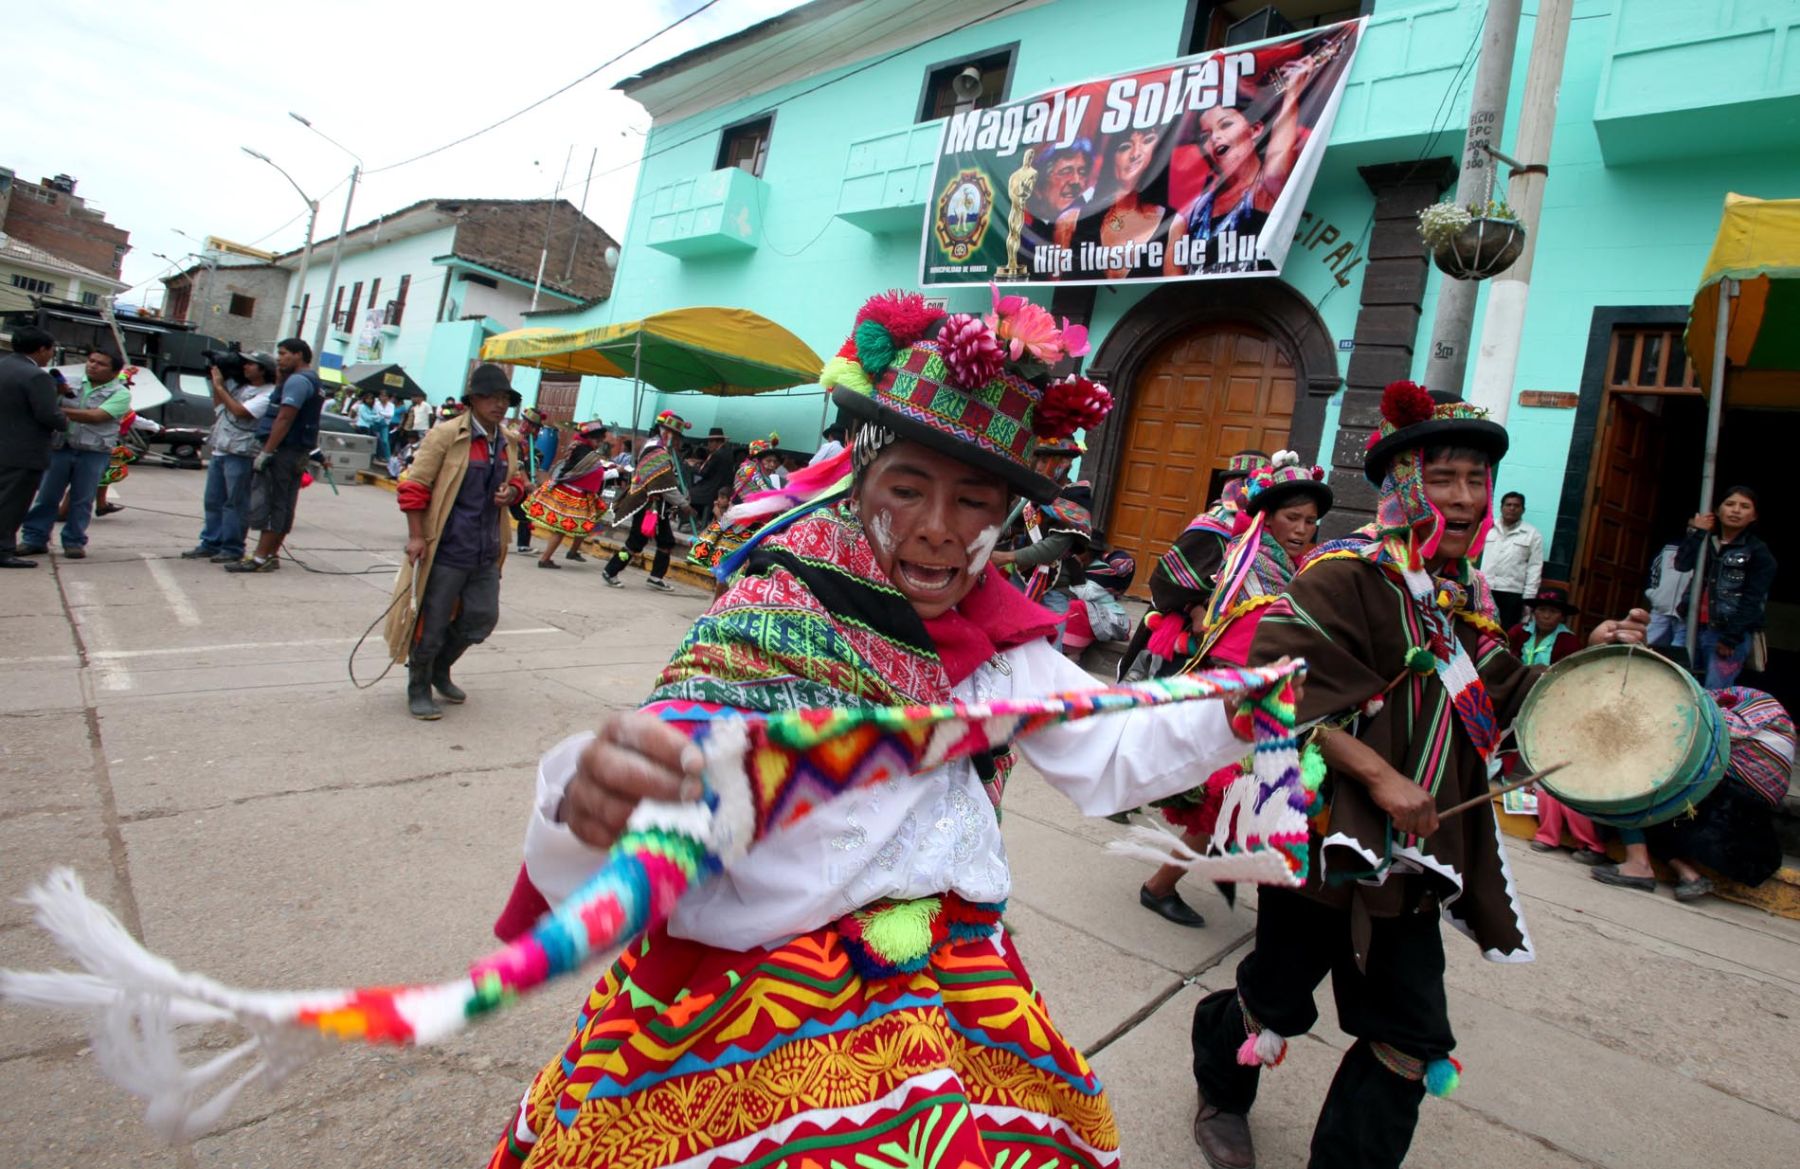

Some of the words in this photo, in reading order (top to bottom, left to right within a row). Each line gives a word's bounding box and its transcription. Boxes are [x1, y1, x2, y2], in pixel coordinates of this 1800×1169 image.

[945, 90, 1091, 157] Magaly
[1469, 126, 1492, 137] EPC
[1034, 244, 1073, 277] Hija
[1080, 240, 1163, 271] ilustre
[1174, 234, 1206, 265] de
